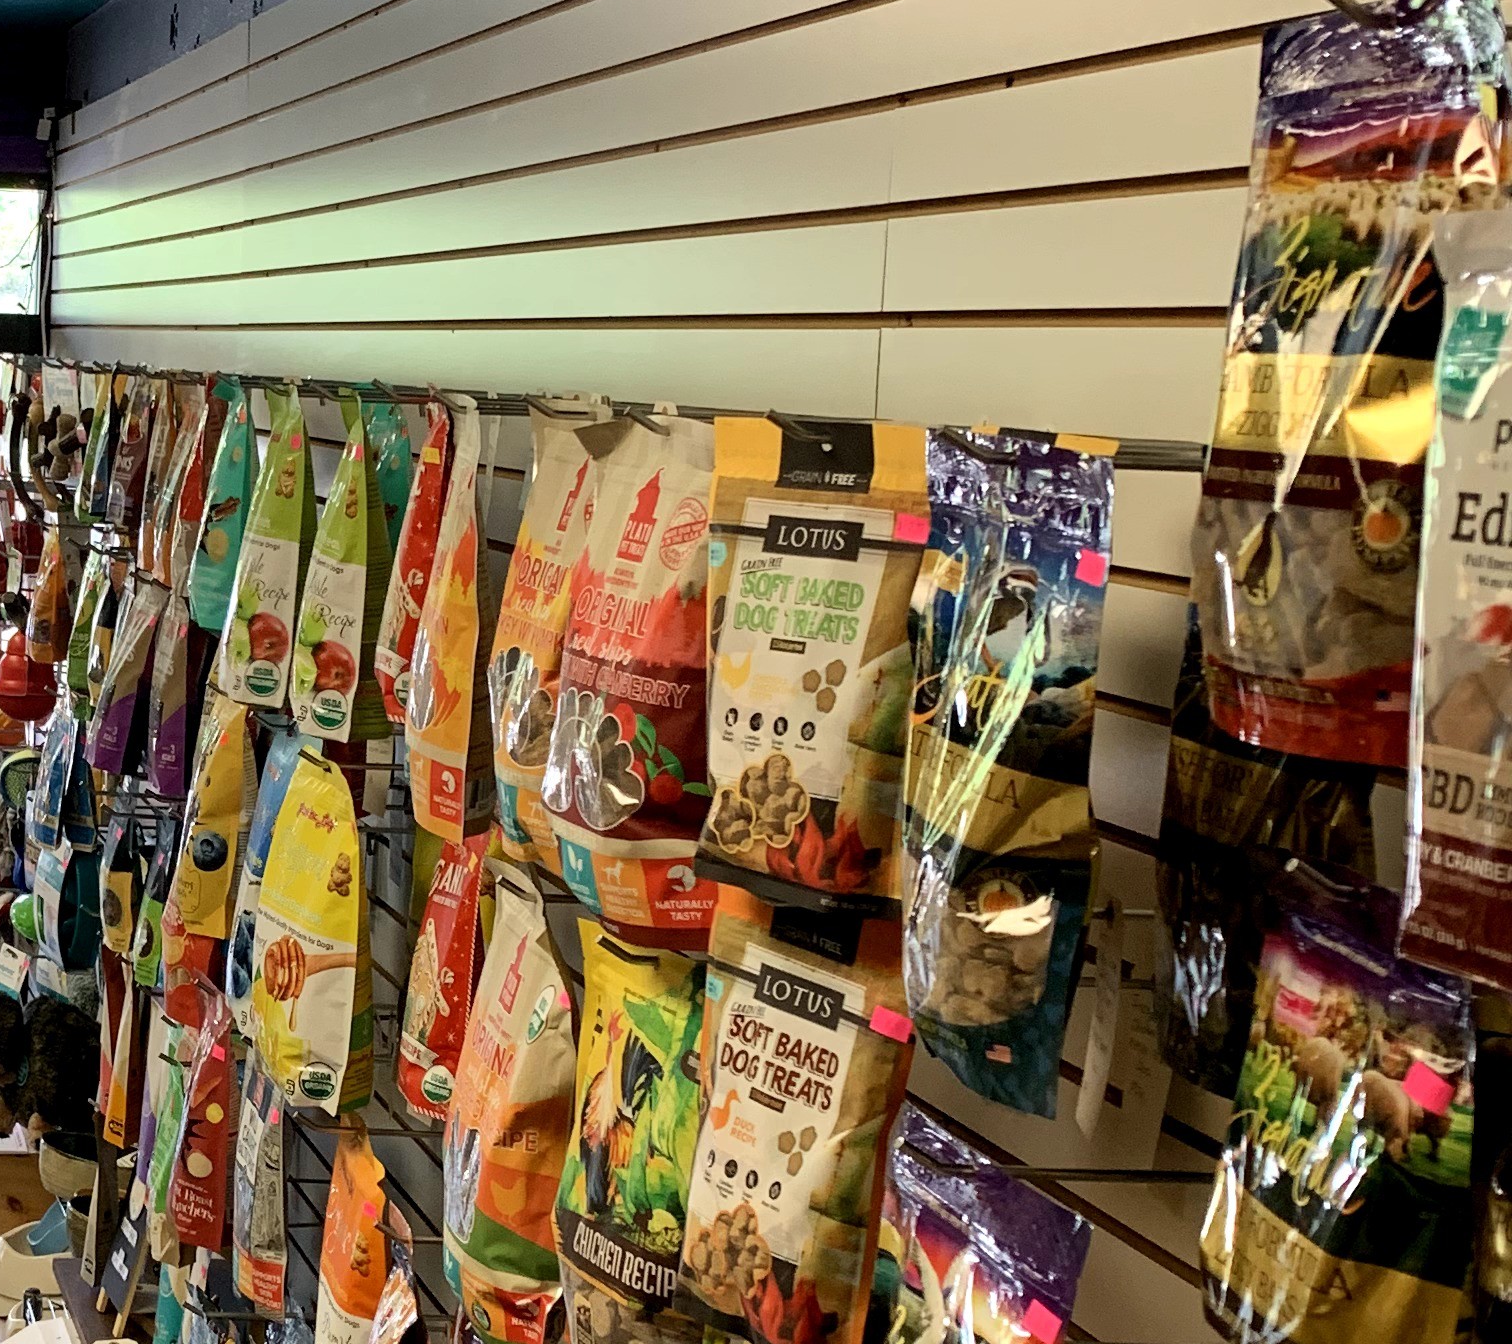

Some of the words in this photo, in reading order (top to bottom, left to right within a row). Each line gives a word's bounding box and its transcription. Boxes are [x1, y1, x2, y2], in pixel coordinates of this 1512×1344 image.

[830, 473, 856, 487] FREE
[777, 524, 848, 552] LOTUS
[740, 571, 795, 602] SOFT
[796, 576, 865, 612] BAKED
[733, 601, 780, 635] DOG
[785, 609, 860, 645] TREATS
[655, 898, 714, 912] NATURALLY
[669, 910, 703, 923] TASTY
[316, 938, 334, 951] Dogs
[762, 974, 835, 1020] LOTUS
[727, 1014, 774, 1051] SOFT
[774, 1030, 840, 1080] BAKED
[308, 1070, 332, 1082] USDA
[719, 1041, 760, 1080] DOG
[761, 1060, 834, 1112] TREATS
[572, 1221, 621, 1280] CHICKEN
[620, 1245, 677, 1298] RECIP
